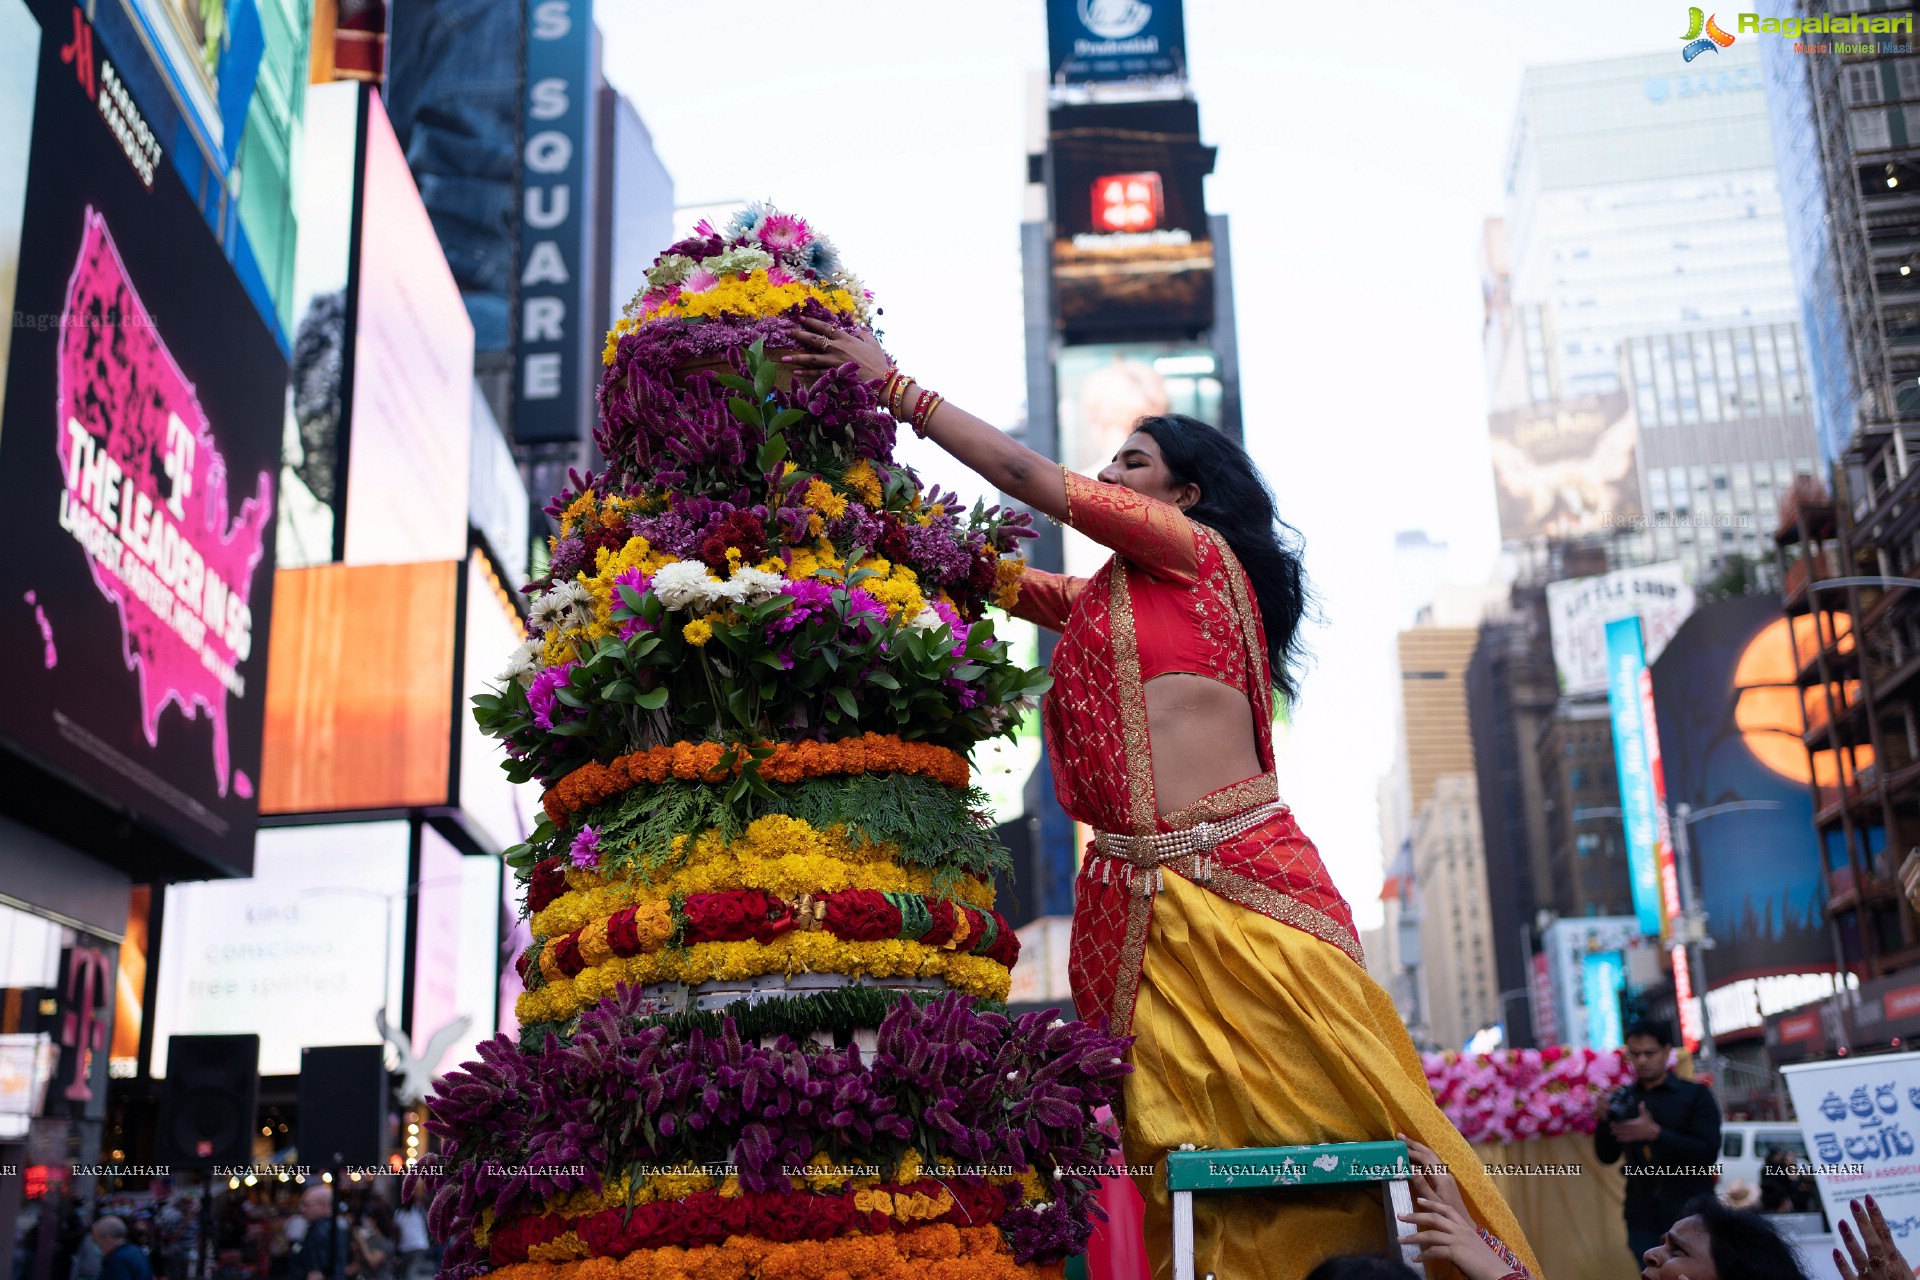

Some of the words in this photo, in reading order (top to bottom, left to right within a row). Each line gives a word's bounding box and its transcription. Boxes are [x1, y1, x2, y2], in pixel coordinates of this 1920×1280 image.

[99, 89, 153, 186] MARQUIS
[101, 60, 162, 168] MARRIOTT
[521, 78, 572, 399] SQUARE
[68, 416, 122, 530] THE
[120, 477, 205, 614] LEADER
[202, 567, 229, 639] IN
[224, 591, 252, 662] 5G
